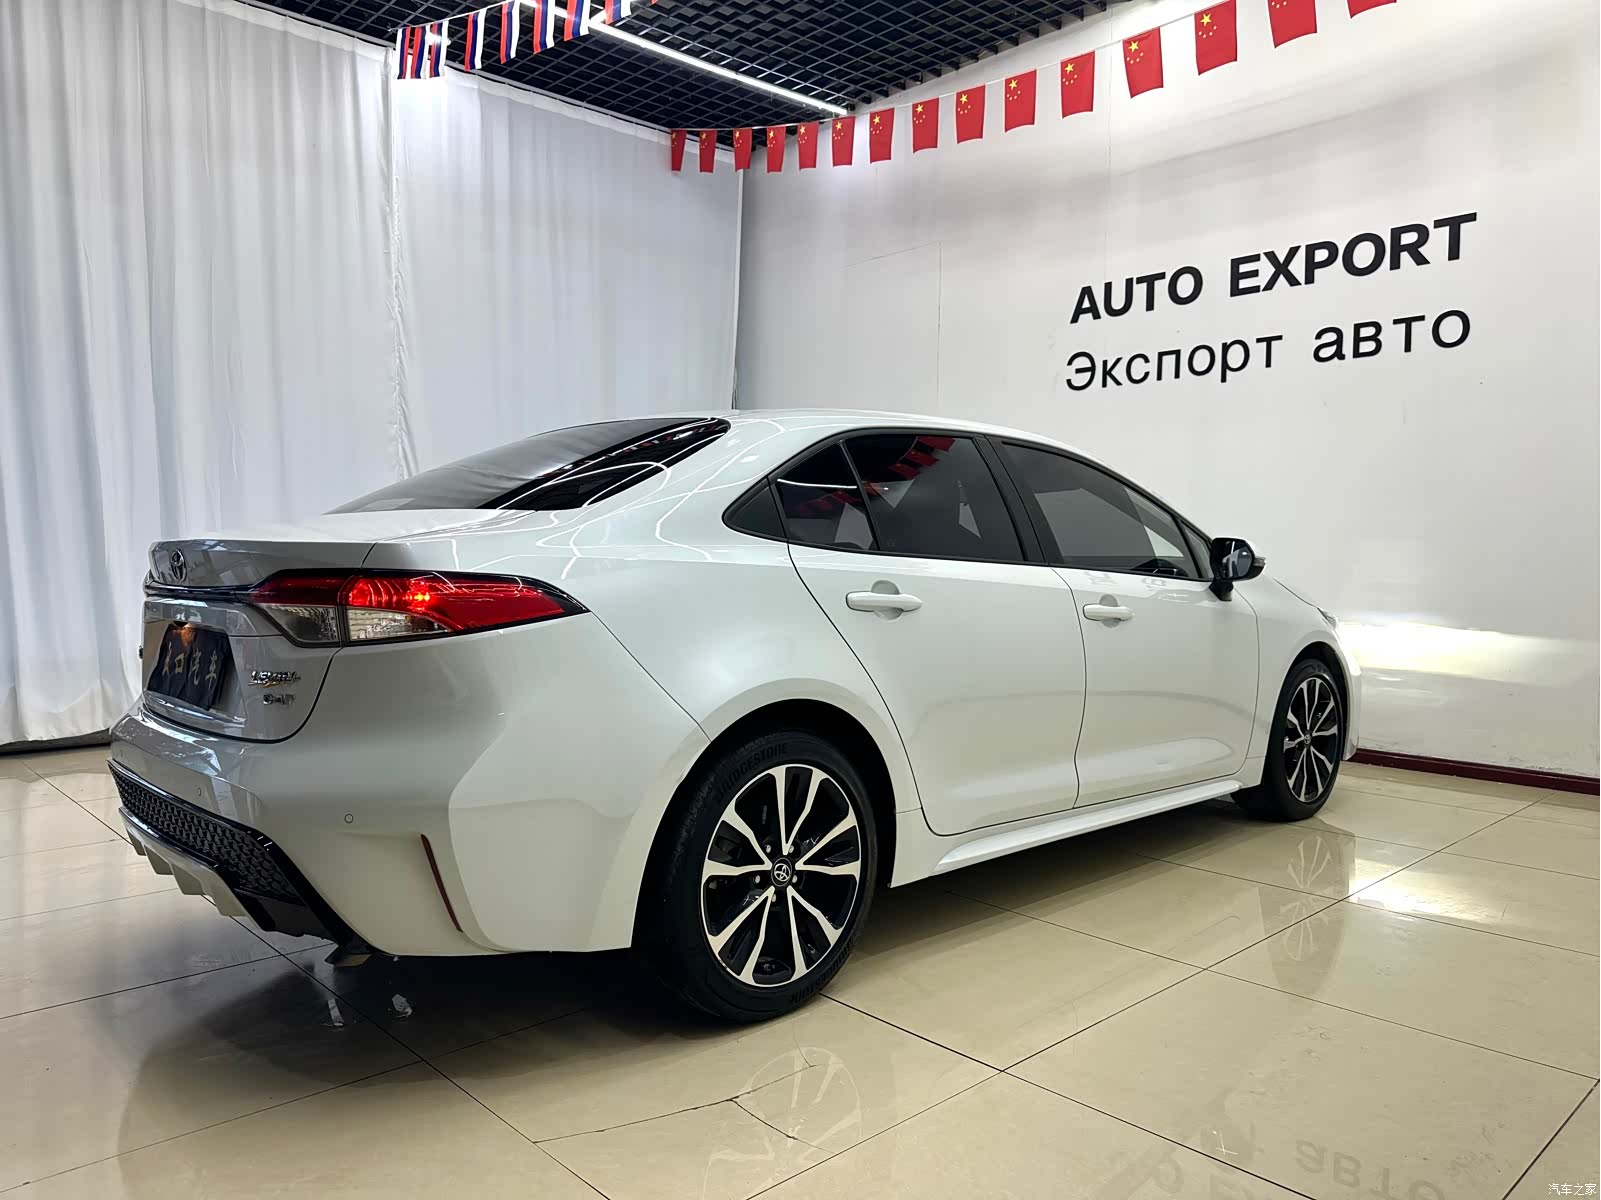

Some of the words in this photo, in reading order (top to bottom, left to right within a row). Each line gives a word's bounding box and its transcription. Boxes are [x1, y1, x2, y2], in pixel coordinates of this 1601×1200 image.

[1070, 265, 1204, 324] AUTO
[1229, 212, 1478, 297] EXPORT
[1065, 334, 1283, 392] Экспорт
[1312, 309, 1471, 363] авто
